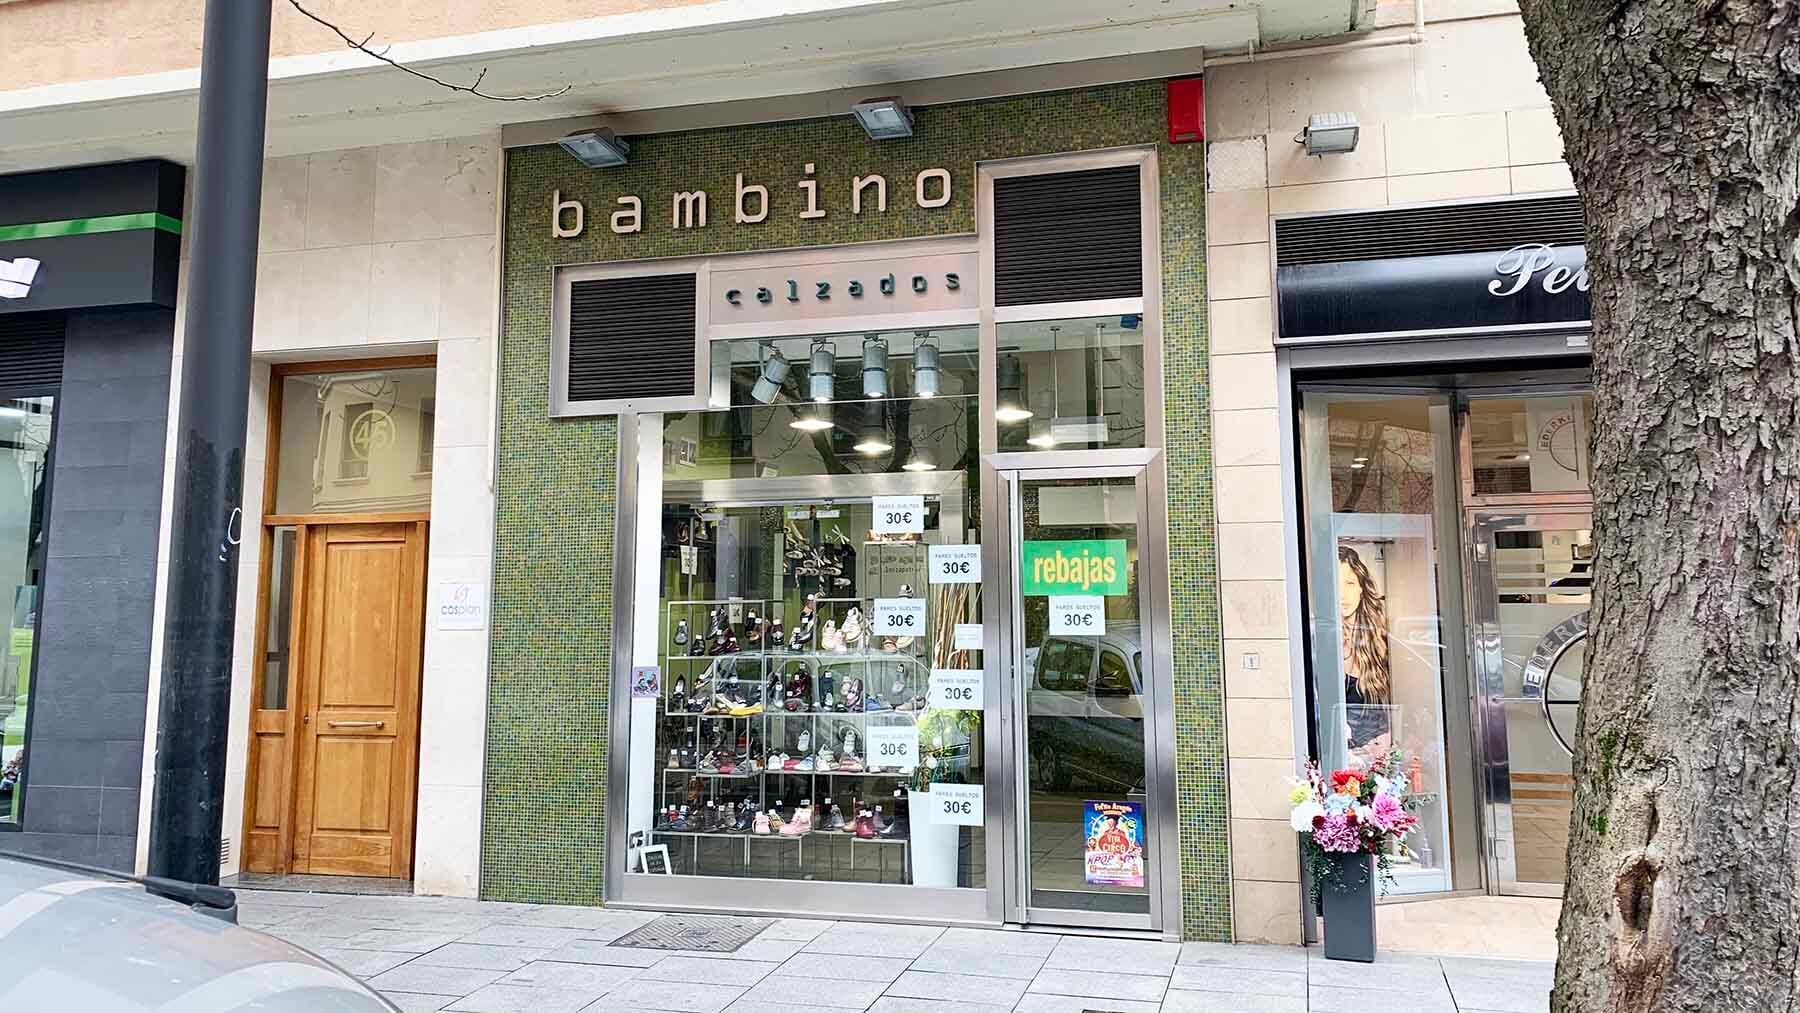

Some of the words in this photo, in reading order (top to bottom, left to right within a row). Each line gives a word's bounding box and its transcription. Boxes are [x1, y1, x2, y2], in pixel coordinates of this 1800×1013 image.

[551, 162, 953, 238] bambino
[725, 270, 962, 305] calzados
[886, 512, 912, 524] 30€
[943, 562, 970, 574] 30€
[1034, 549, 1117, 591] rebajas
[887, 614, 914, 627] 30€
[1064, 613, 1093, 626] 30€
[944, 687, 973, 700] 30€
[880, 743, 907, 757] 30€
[943, 800, 972, 815] 30€
